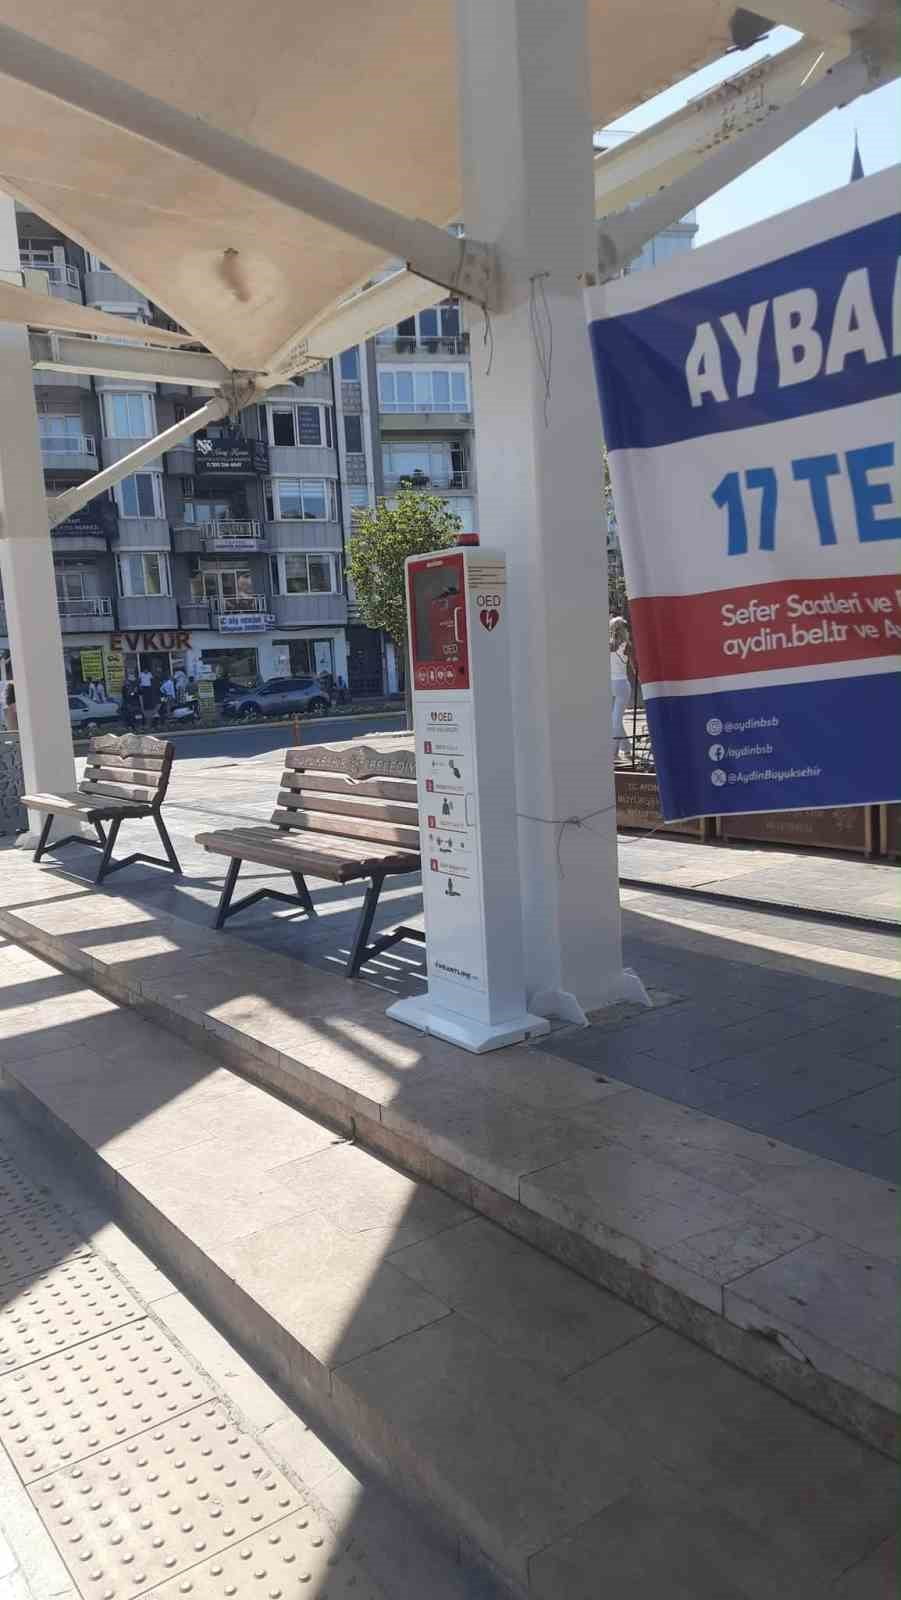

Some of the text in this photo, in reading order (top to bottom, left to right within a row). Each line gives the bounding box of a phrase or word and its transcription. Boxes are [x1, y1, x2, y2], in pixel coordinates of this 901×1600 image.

[711, 467, 778, 556] 17
[721, 600, 780, 627] Sefer
[786, 592, 863, 618] Saatleri
[867, 598, 892, 613] ve
[110, 631, 192, 652] EVKUR
[854, 625, 880, 639] ve
